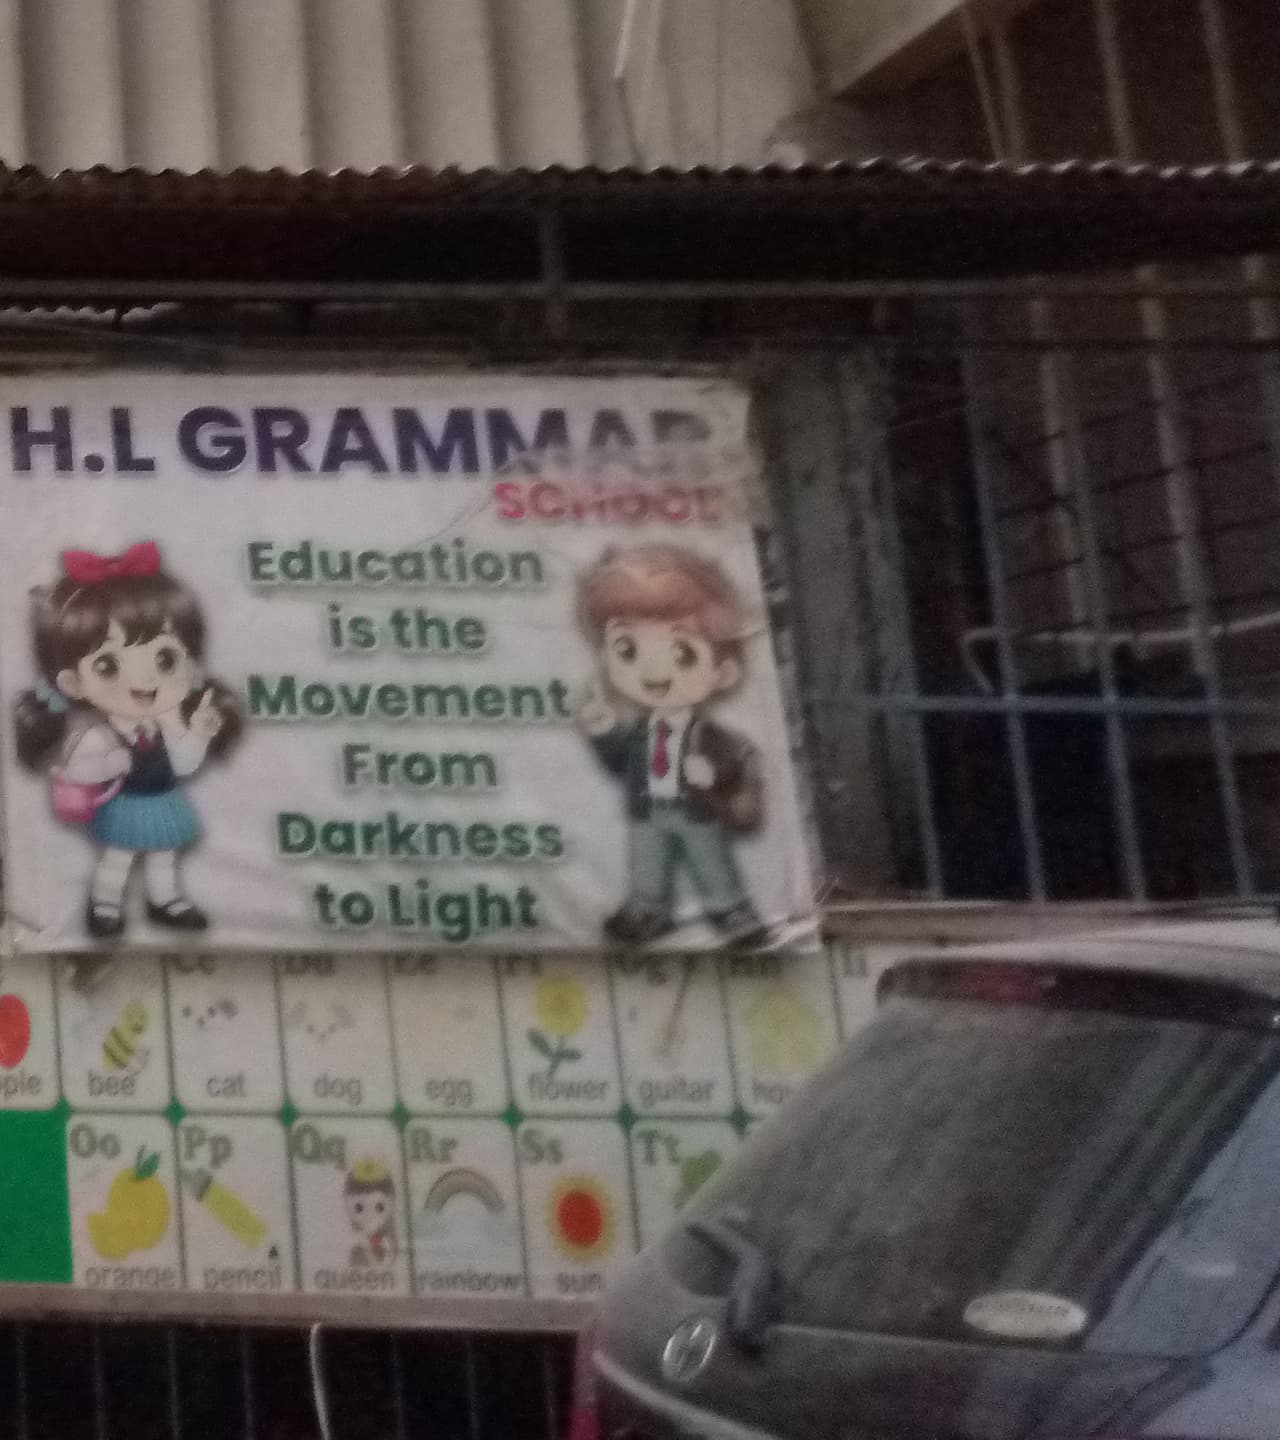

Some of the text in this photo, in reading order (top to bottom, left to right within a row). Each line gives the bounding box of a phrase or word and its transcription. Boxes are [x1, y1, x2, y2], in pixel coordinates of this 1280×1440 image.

[10, 405, 157, 474] H.L
[247, 540, 545, 586] Education
[328, 604, 487, 652] is the
[245, 674, 574, 721] Movement
[341, 742, 499, 789] From
[276, 811, 565, 858] Darkness
[313, 879, 541, 944] to Light
[89, 1071, 137, 1096] bee
[206, 1072, 245, 1098] cat
[313, 1074, 362, 1104] dog
[426, 1080, 475, 1106] egg
[528, 1073, 608, 1101] flower
[640, 1077, 714, 1108] guitar
[557, 1272, 604, 1294] sun
